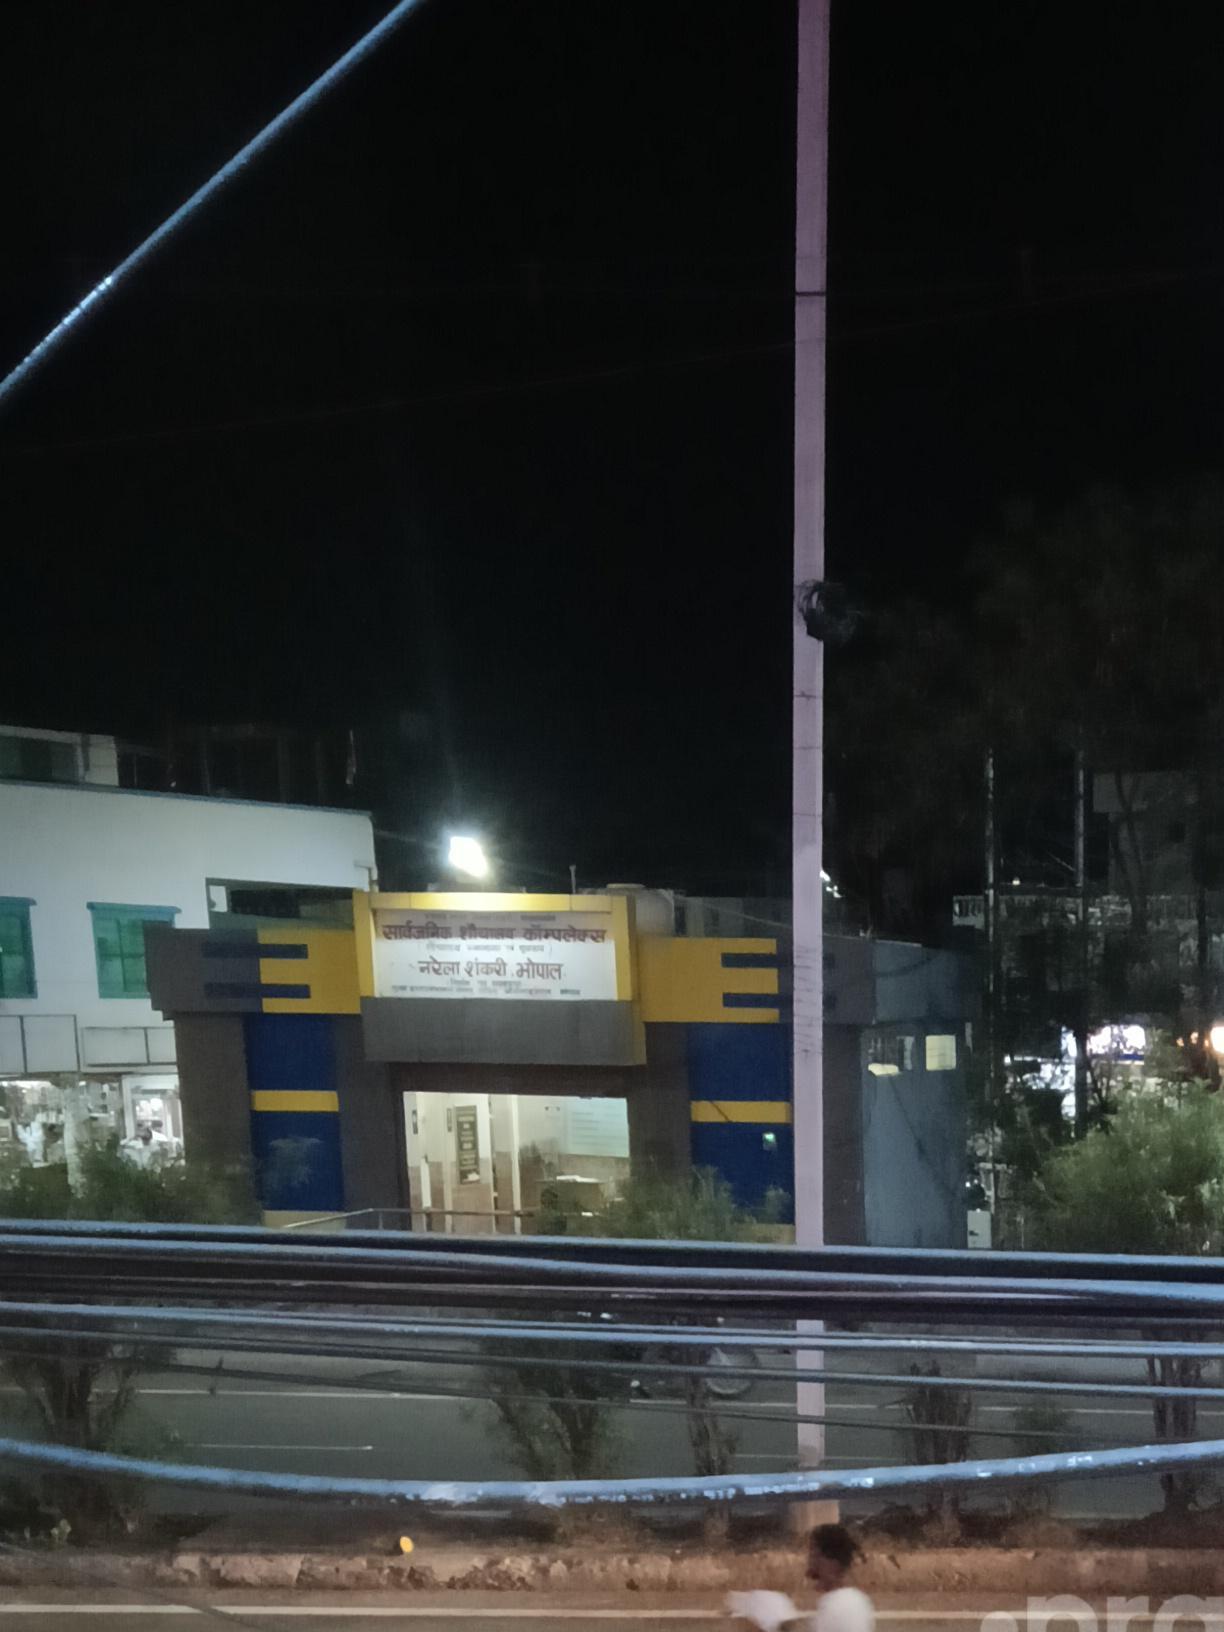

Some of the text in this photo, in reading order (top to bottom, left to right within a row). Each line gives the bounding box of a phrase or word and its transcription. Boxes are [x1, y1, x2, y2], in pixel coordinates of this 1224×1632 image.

[418, 955, 563, 980] नरेला शंकरी भोपाल
